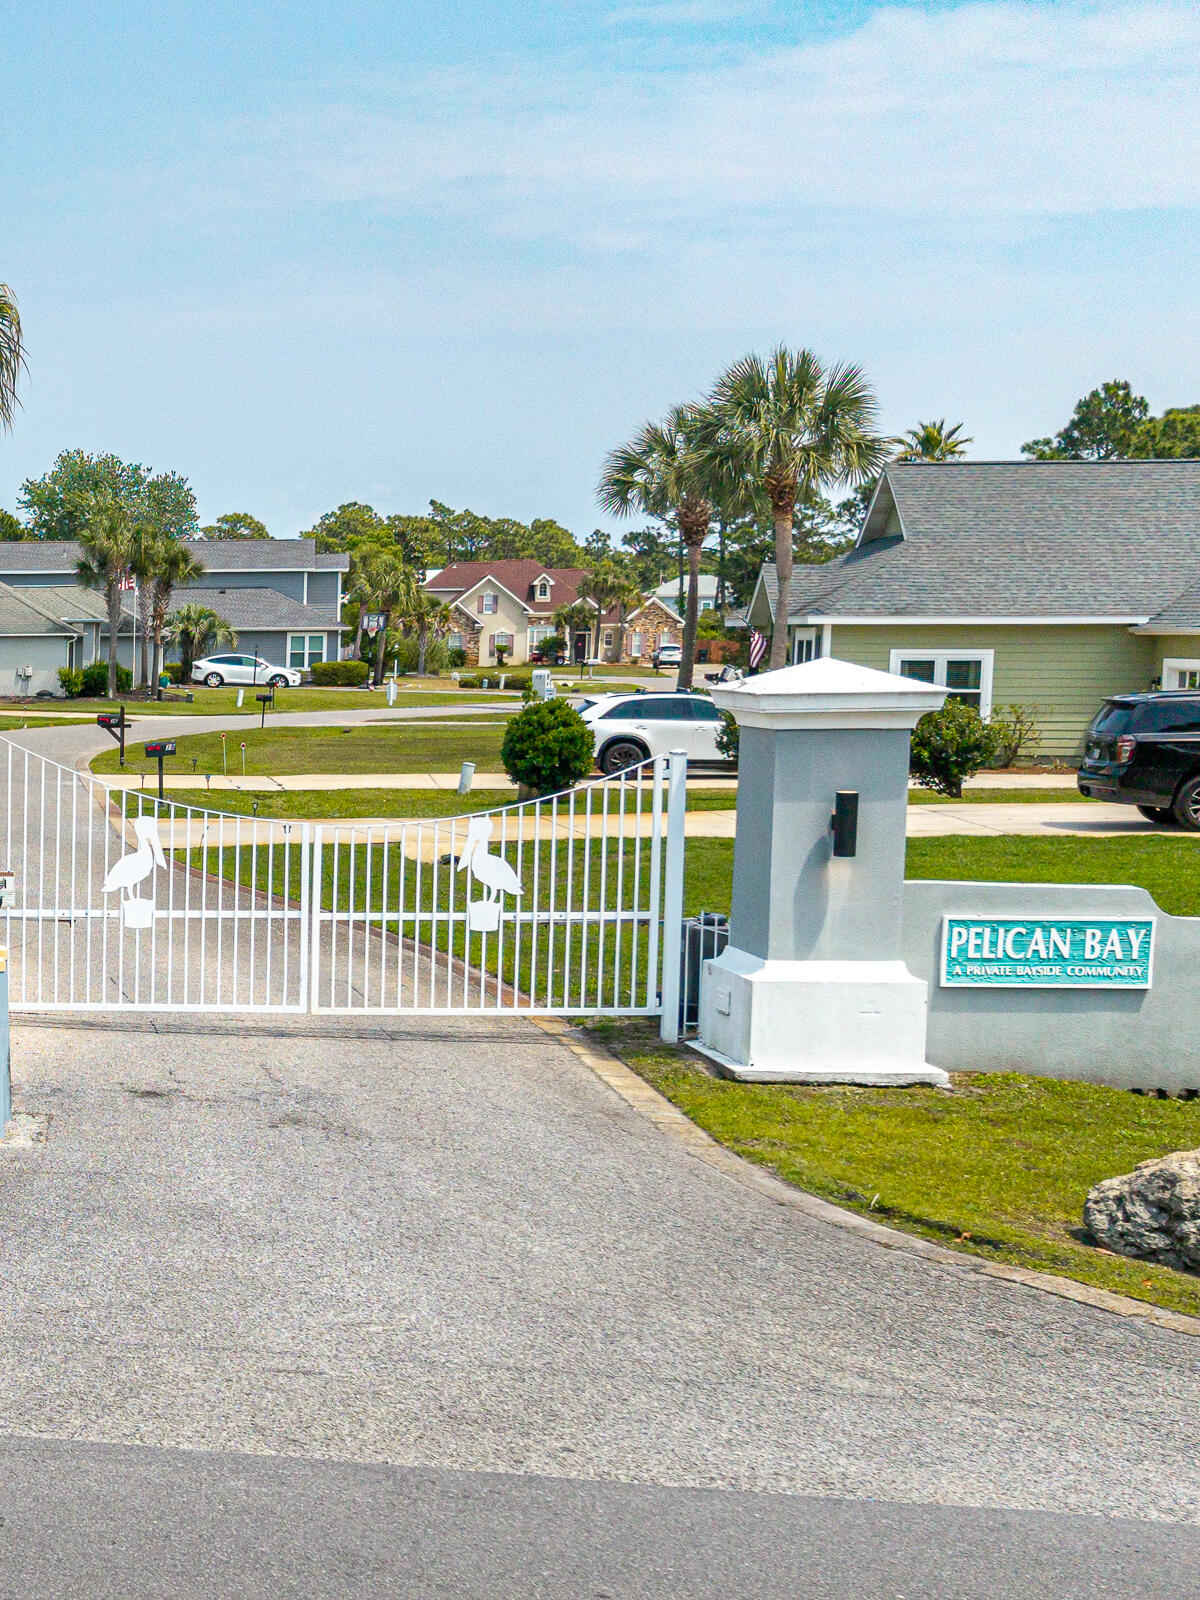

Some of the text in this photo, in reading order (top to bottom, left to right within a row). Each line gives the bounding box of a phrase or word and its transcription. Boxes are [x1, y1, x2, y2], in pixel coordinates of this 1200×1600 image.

[950, 927, 1147, 960] PELICAN BAY
[952, 965, 1144, 977] A PRIVATE BAYSIDE COMMUNITY
